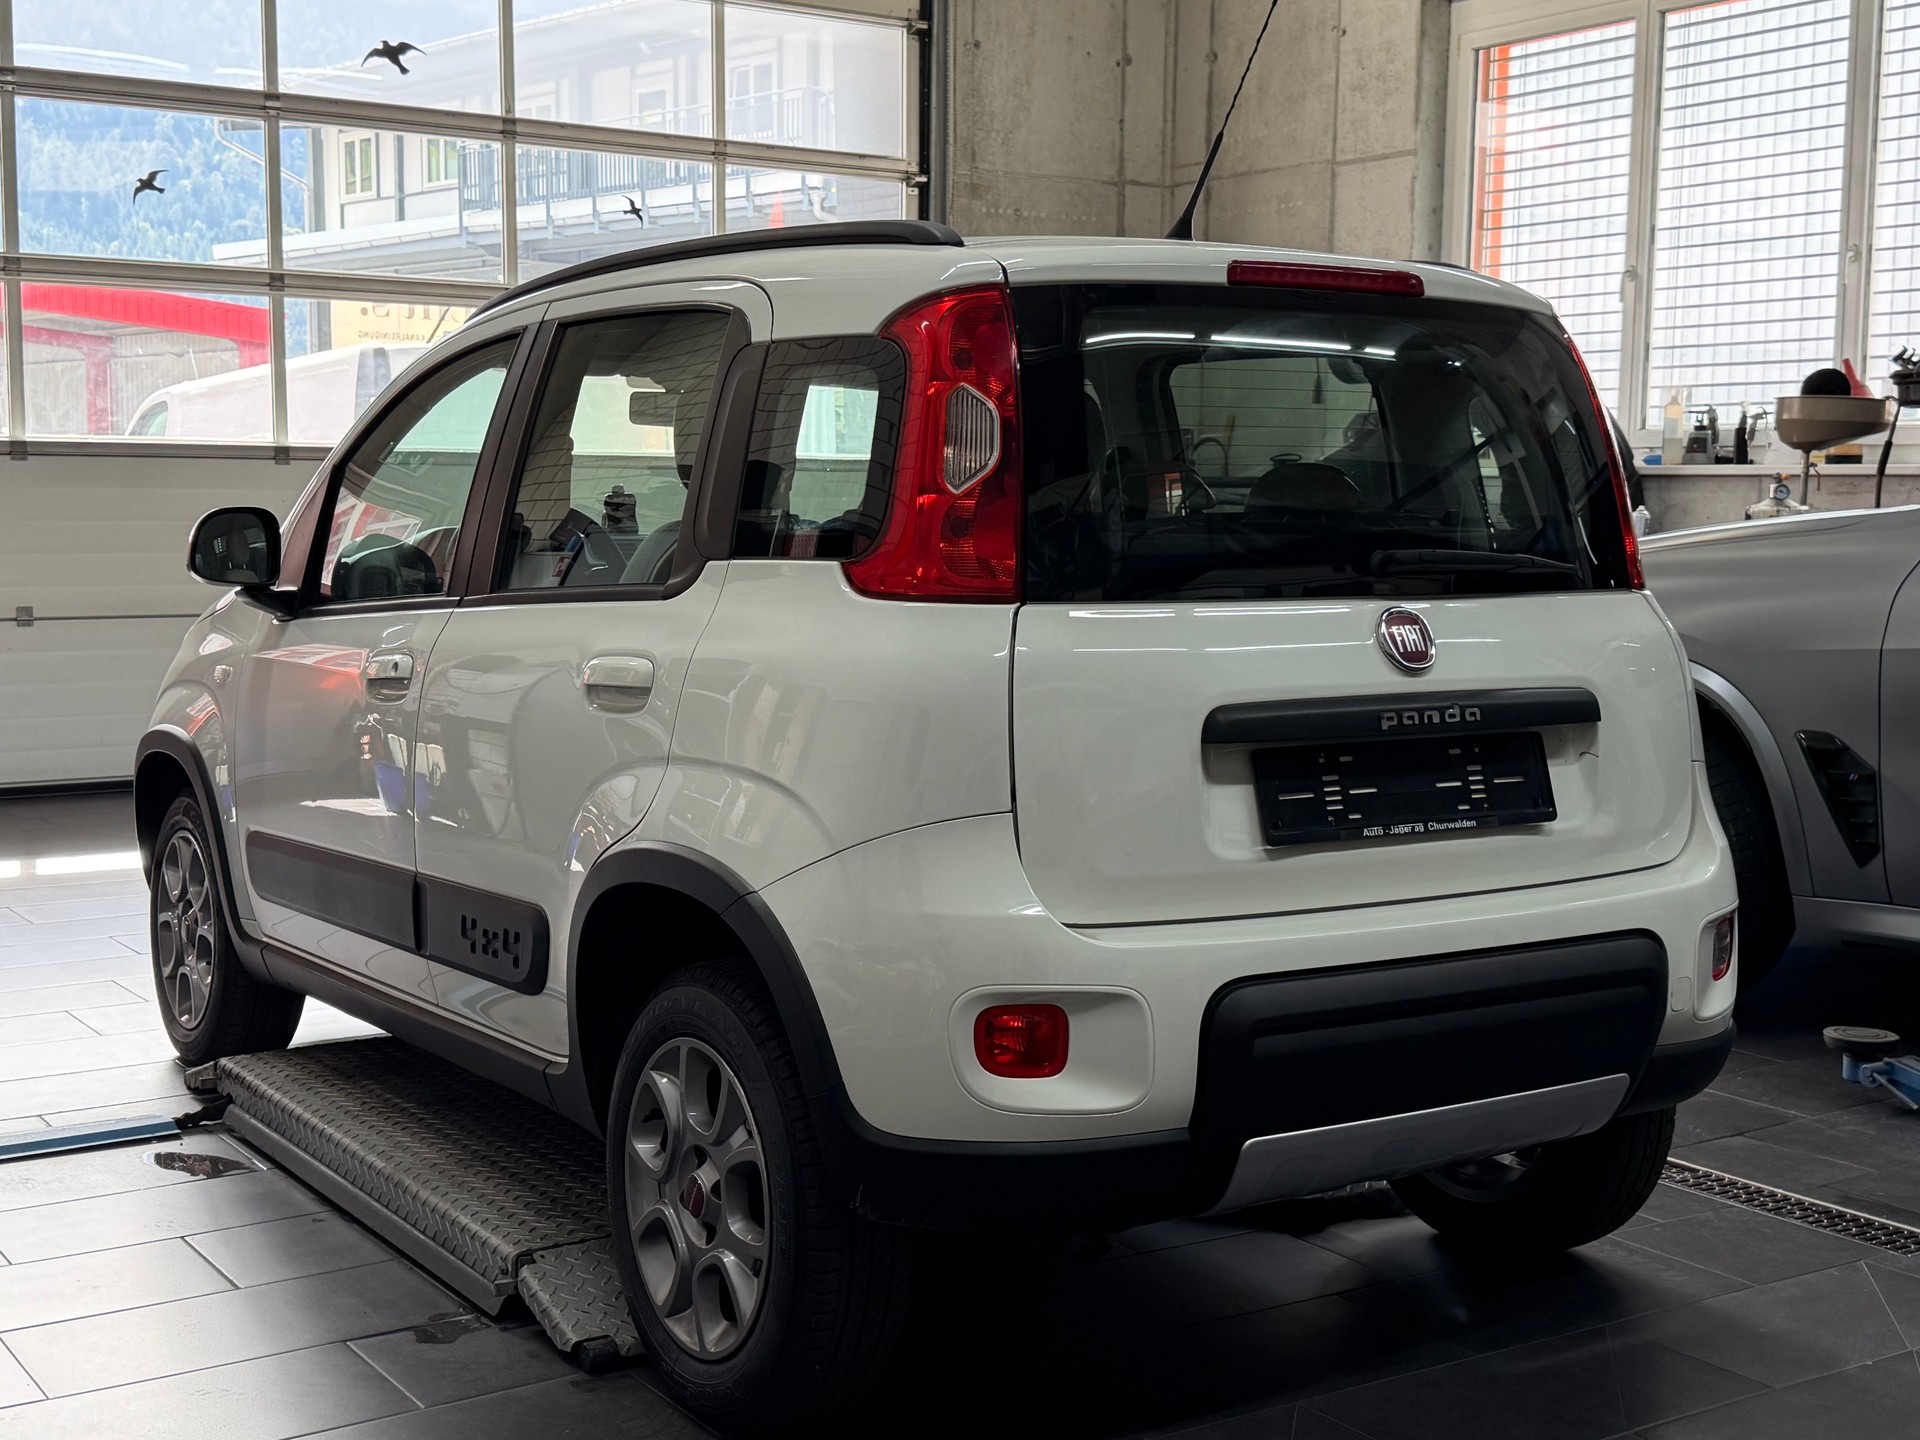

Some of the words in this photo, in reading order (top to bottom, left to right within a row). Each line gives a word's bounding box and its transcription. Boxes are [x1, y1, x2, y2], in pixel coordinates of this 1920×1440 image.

[1390, 625, 1426, 652] FIAT
[1381, 704, 1481, 730] panda
[1363, 827, 1384, 837] Auto
[1428, 820, 1477, 831] Churwalden
[461, 913, 521, 970] 4x4
